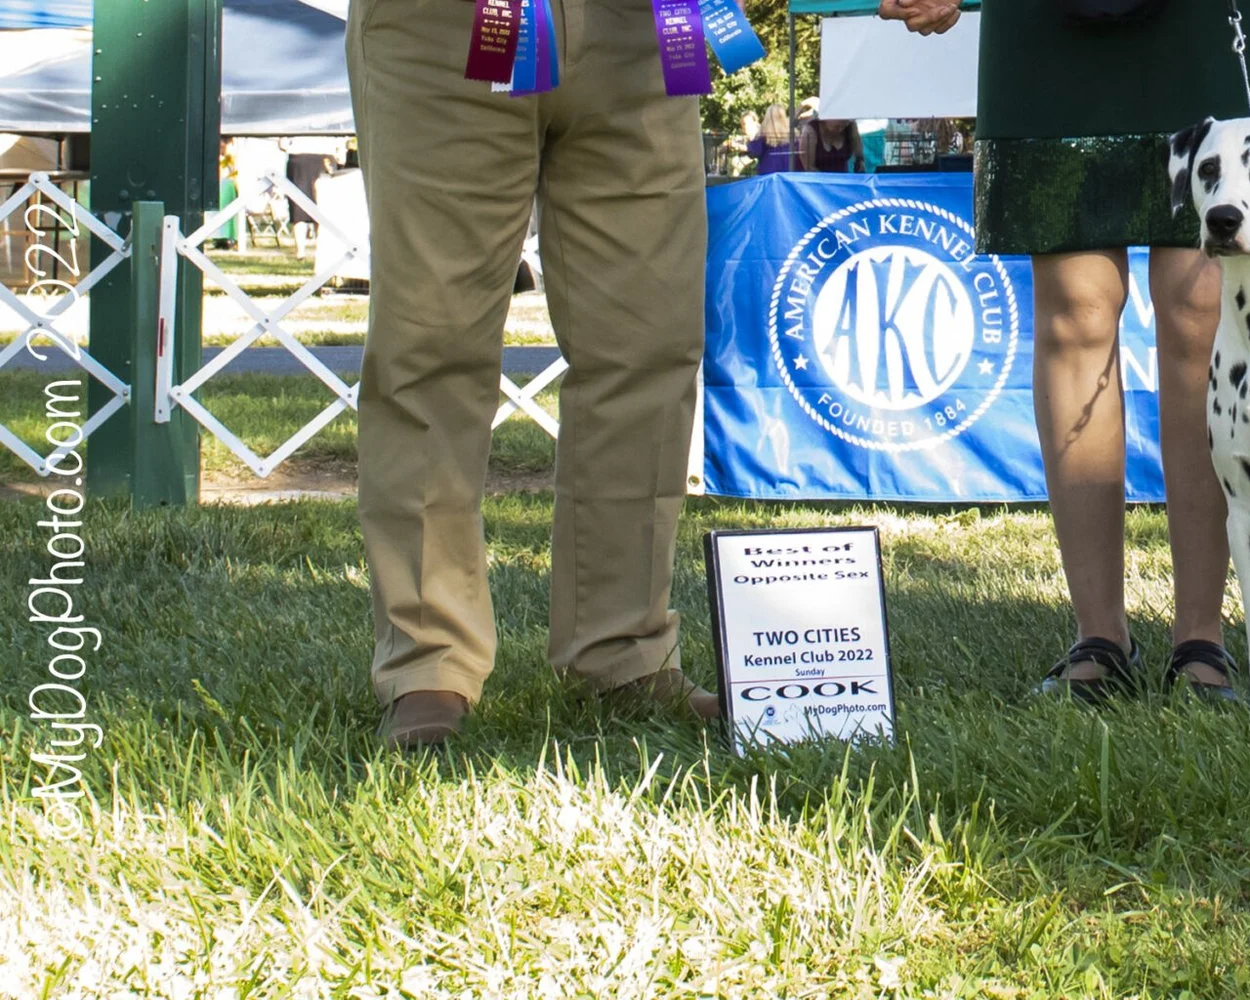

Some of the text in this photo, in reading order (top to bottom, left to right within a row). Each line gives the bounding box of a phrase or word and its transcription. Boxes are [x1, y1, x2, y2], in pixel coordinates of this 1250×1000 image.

[784, 214, 1003, 345] AMERICAN KENNEL CLUB
[822, 252, 963, 403] AKC
[817, 392, 968, 437] FOUNDED 1884
[743, 542, 854, 556] Best of
[750, 557, 856, 568] Winners
[733, 570, 869, 585] Opposite Sex
[753, 627, 861, 646] TWO CITIES
[744, 648, 873, 667] Kennel Club 2022
[795, 667, 825, 677] Sunday
[740, 680, 878, 701] COOK
[804, 703, 887, 716] MyDogPhoto.com
